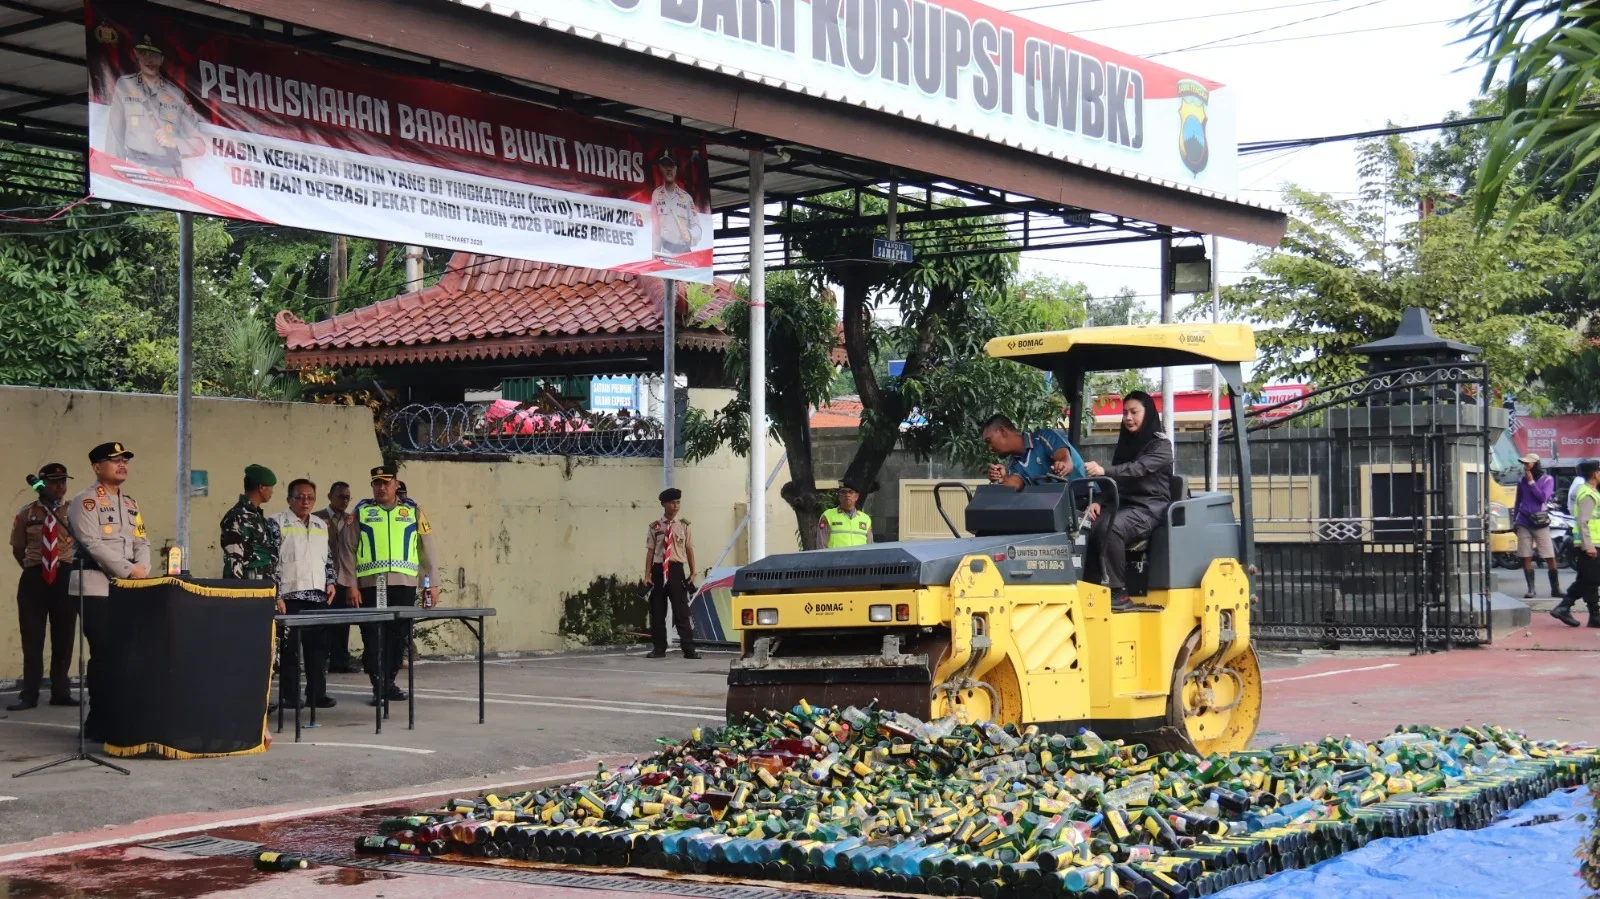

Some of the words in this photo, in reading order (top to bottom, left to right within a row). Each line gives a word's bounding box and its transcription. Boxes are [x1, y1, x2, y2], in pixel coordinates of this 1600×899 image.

[660, 0, 795, 53] RI
[200, 60, 390, 135] PEMUSNAHAN
[398, 103, 495, 156] BARANG
[500, 125, 569, 170] BUKTI
[574, 140, 644, 183] MIRAS
[212, 137, 262, 164] HASIL
[263, 147, 340, 178] KEGIATAN
[343, 162, 385, 185] RUTIN
[388, 170, 426, 192] YANG
[429, 177, 442, 195] DI
[445, 180, 525, 209] TINGKATKAN
[528, 192, 573, 219] (KRYD)
[574, 203, 615, 223] TAHUN
[616, 210, 644, 227] 2026
[231, 167, 265, 189] DAN
[269, 173, 301, 195] DAN
[305, 179, 368, 206] OPERASI
[372, 190, 417, 214] PEKAT
[420, 198, 461, 221] CANDI
[463, 206, 508, 227] TAHUN
[510, 213, 542, 233] 2026
[545, 218, 588, 240] POLRES
[590, 225, 634, 246] BREBES
[878, 246, 907, 260] SAMAPTA
[1018, 339, 1044, 348] BOMAG
[1186, 335, 1206, 343] BOMAG
[1244, 393, 1298, 405] Aamart
[1531, 429, 1554, 437] TOKO
[1561, 437, 1584, 445] Baso
[1016, 549, 1038, 557] UNITED
[1039, 548, 1068, 556] TRACTORS
[815, 603, 844, 612] BOMAG
